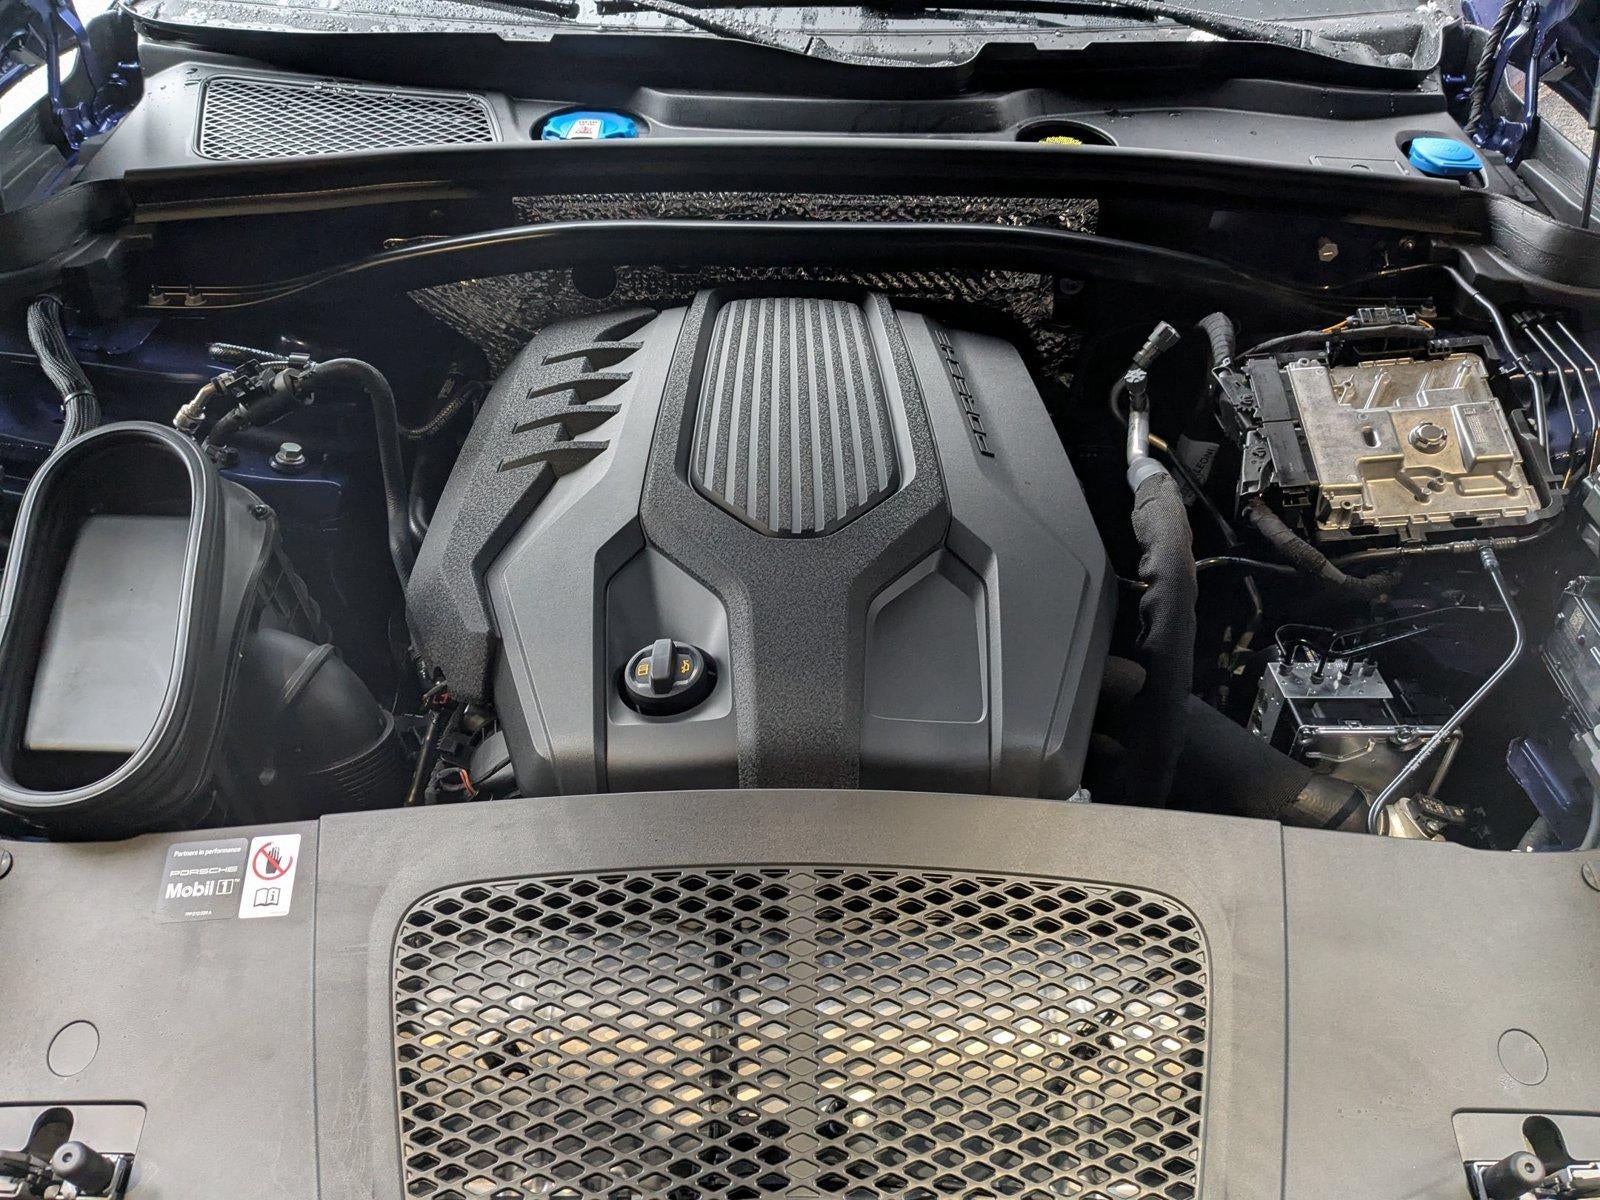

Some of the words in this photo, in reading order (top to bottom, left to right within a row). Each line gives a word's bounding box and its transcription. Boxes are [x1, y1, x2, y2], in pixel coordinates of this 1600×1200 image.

[935, 330, 995, 458] PORSCHE
[173, 849, 198, 858] Partners
[204, 847, 242, 857] performance
[169, 866, 238, 878] PORSCHE
[165, 880, 215, 899] Mobil
